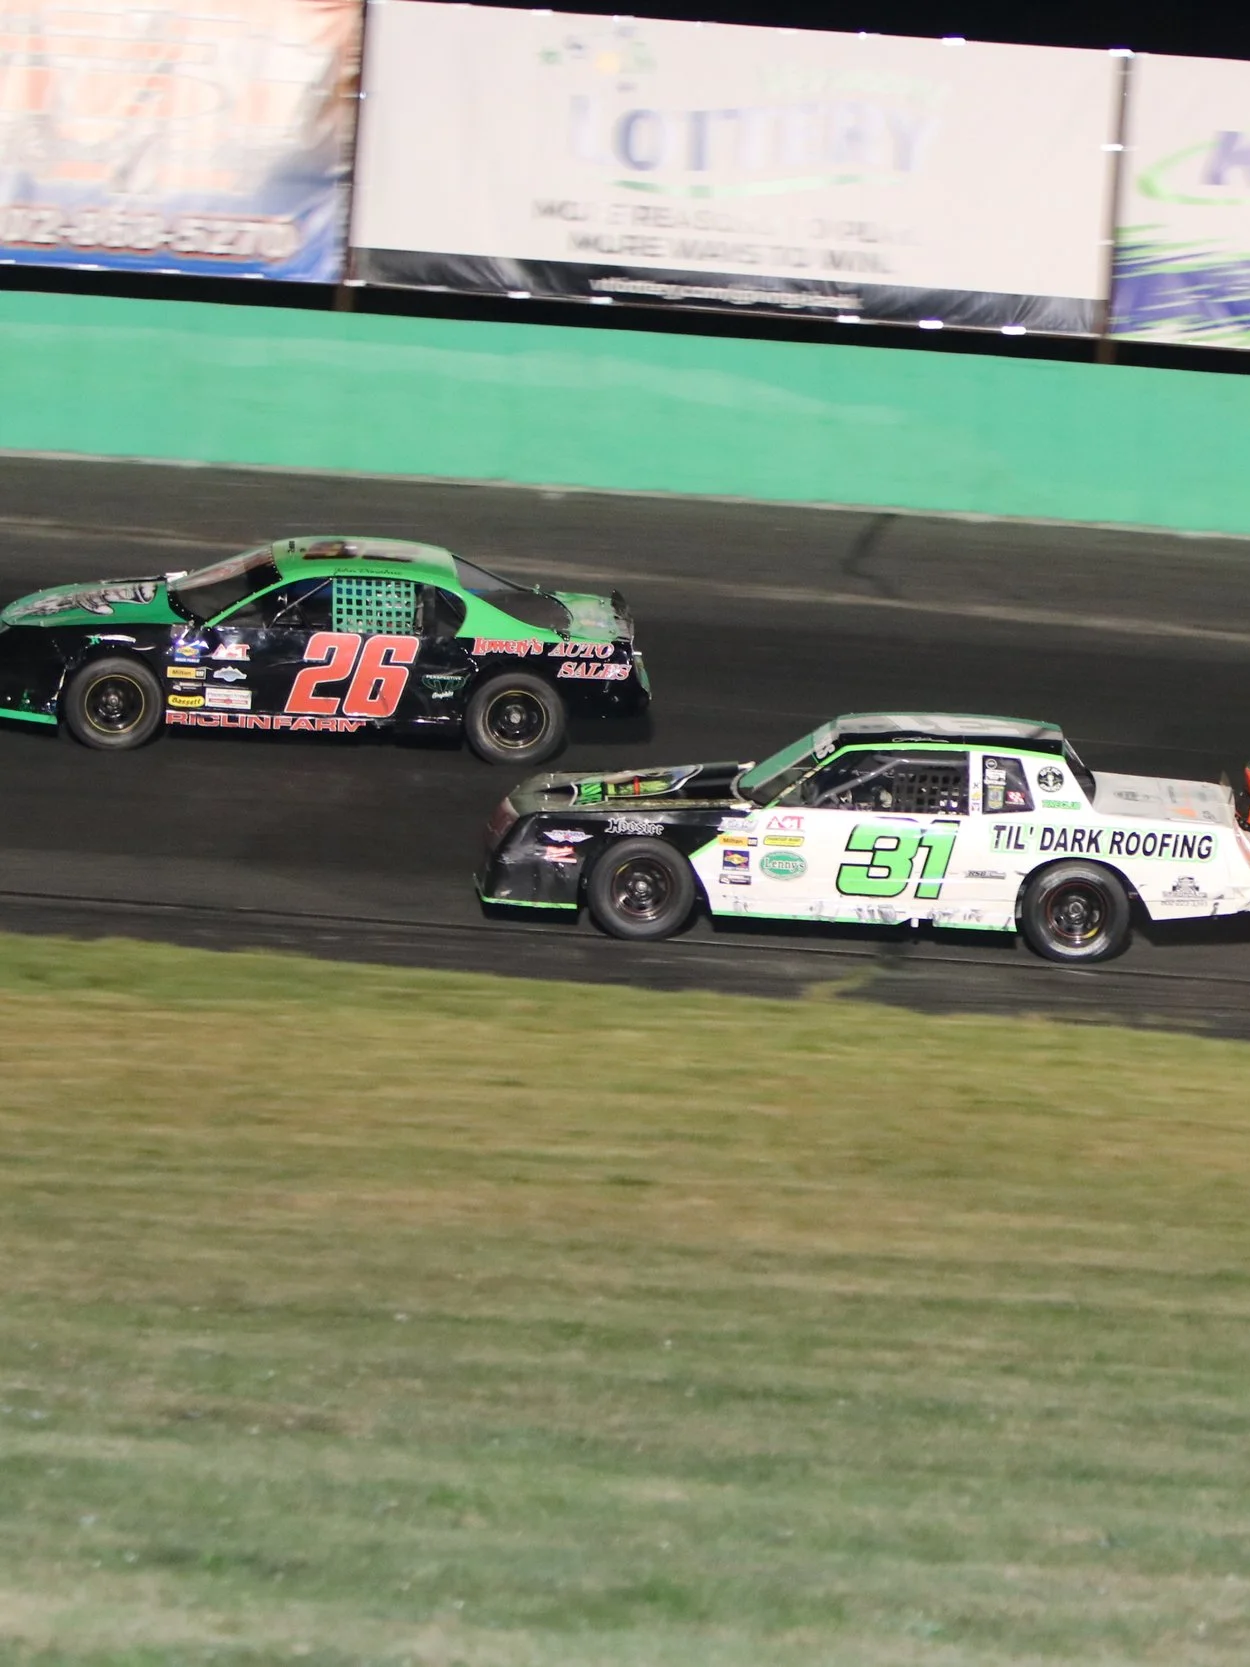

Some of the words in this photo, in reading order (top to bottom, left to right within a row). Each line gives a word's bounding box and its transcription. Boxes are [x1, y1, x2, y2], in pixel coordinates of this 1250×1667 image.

[548, 642, 615, 659] AUTO
[284, 631, 419, 718] 26
[557, 661, 632, 680] SALES
[836, 816, 961, 900] 31
[1039, 827, 1104, 854] DARK
[1109, 830, 1213, 860] ROOFING
